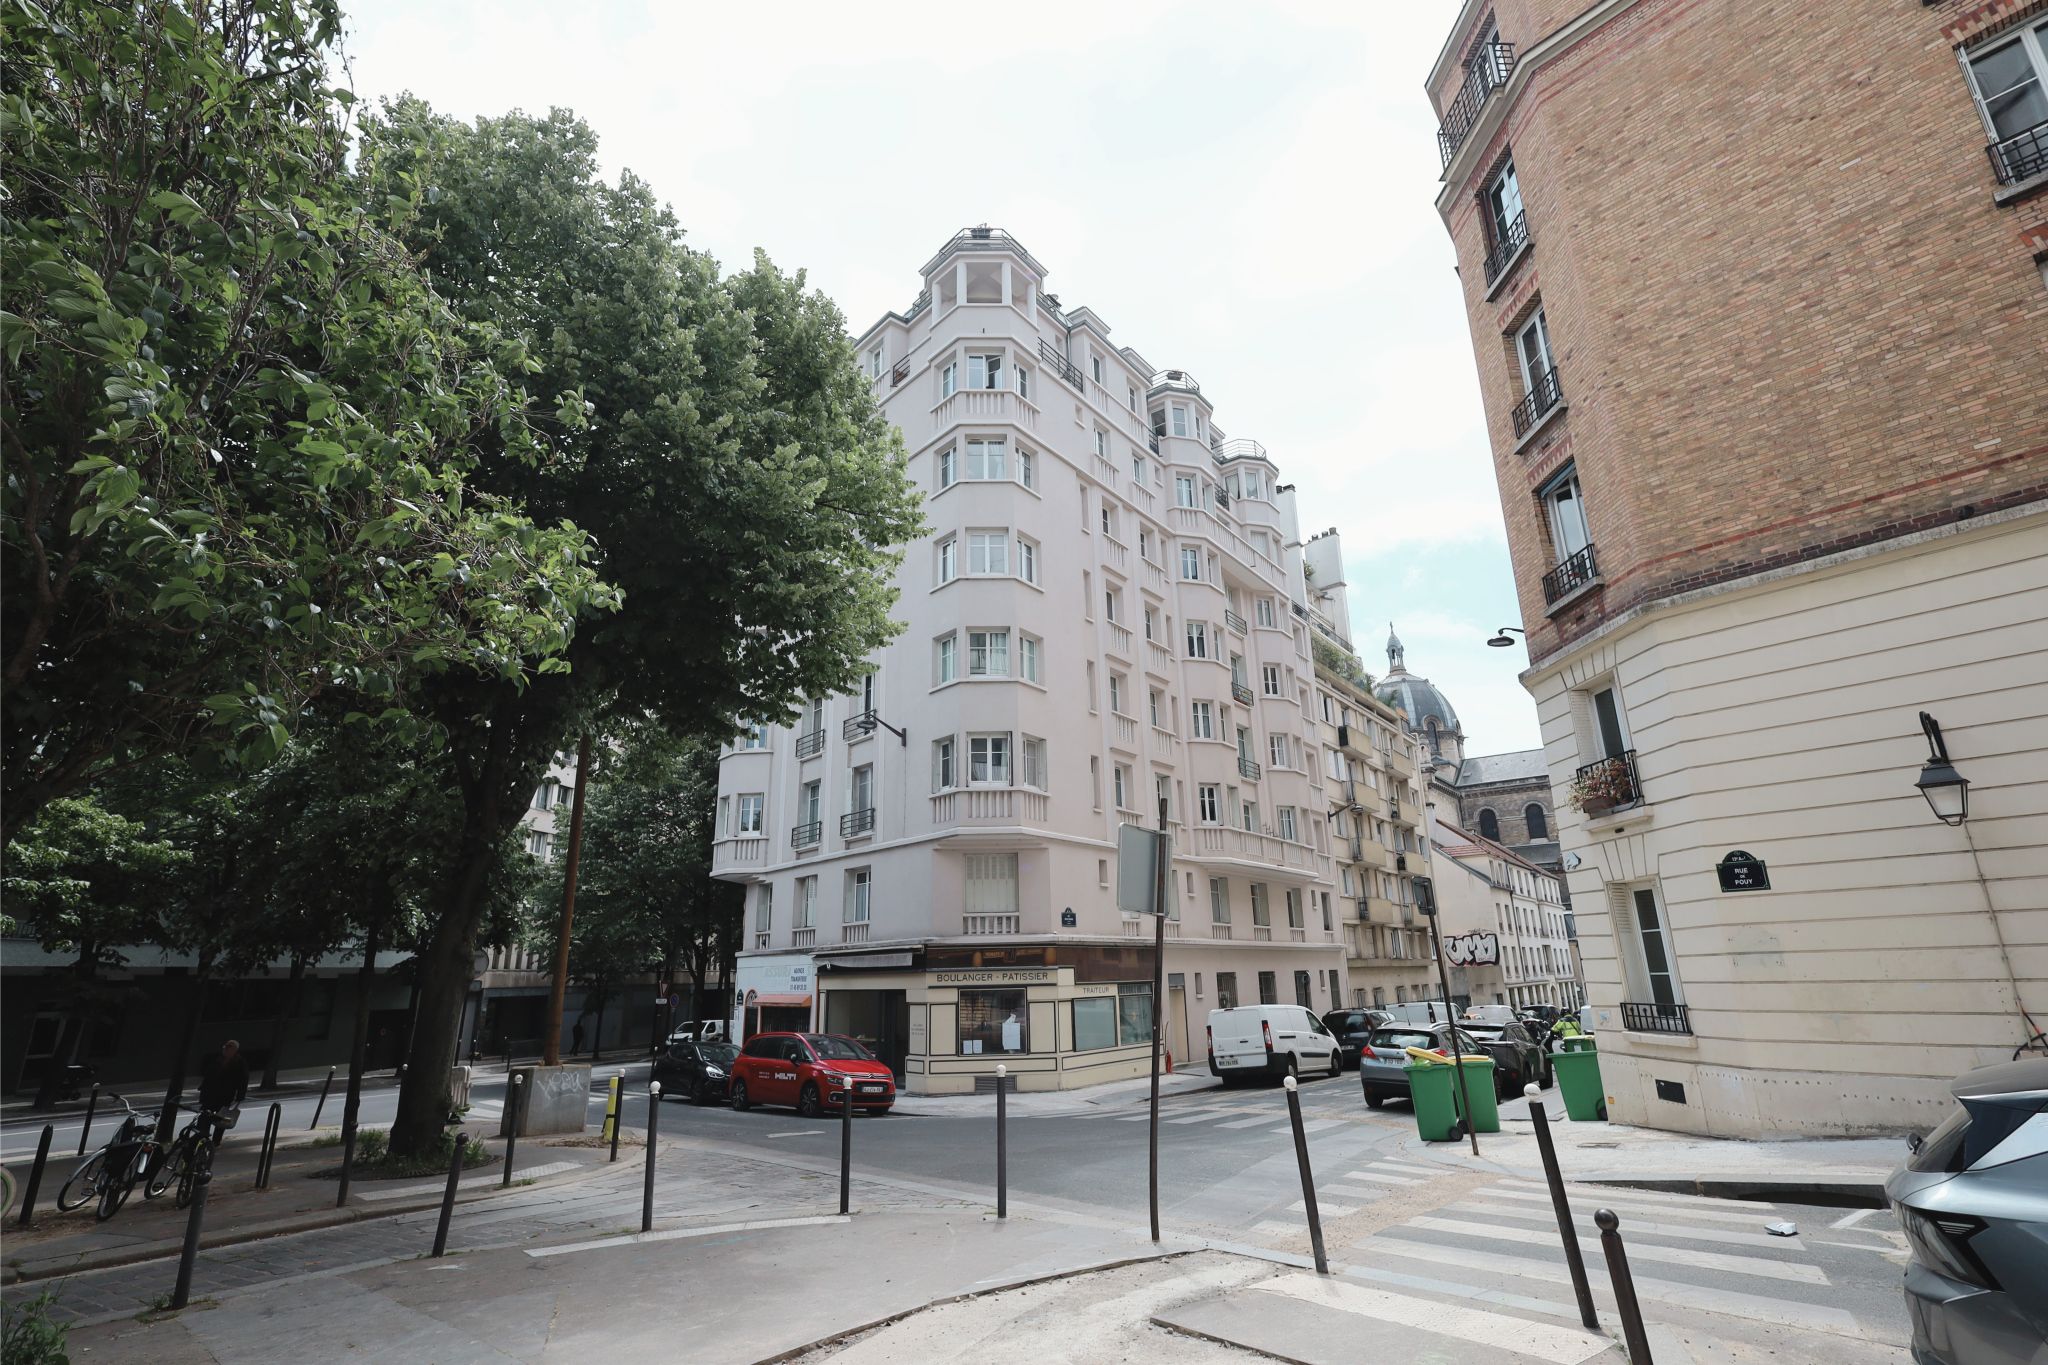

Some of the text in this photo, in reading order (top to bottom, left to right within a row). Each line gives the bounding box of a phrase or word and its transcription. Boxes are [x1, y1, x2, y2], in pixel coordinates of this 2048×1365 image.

[936, 973, 993, 982] BOULANGER
[1002, 972, 1048, 981] PATISSIER
[1083, 986, 1110, 994] TRAITEUR
